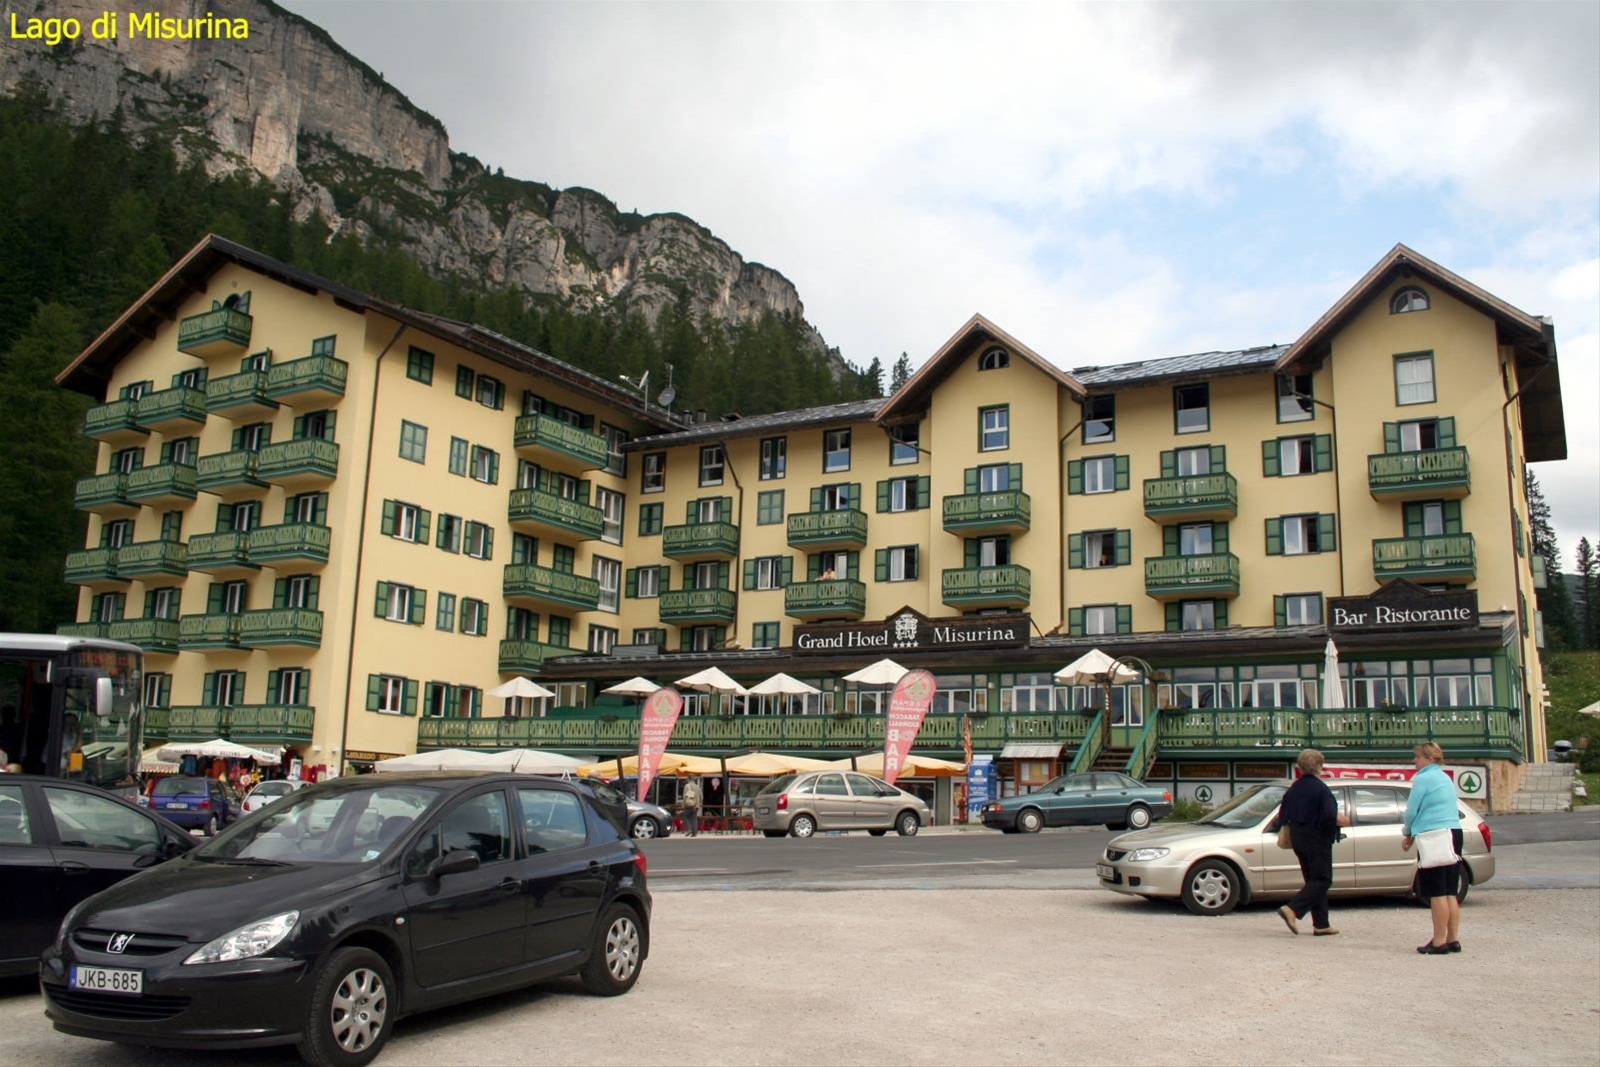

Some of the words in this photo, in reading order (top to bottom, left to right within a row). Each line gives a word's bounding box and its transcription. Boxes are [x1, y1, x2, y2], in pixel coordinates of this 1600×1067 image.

[1334, 608, 1368, 626] Bar
[1376, 606, 1471, 624] Ristorante
[798, 633, 843, 649] Grand
[848, 630, 888, 647] Hotel
[932, 627, 1015, 643] Misurina
[79, 969, 139, 991] JKB-685
